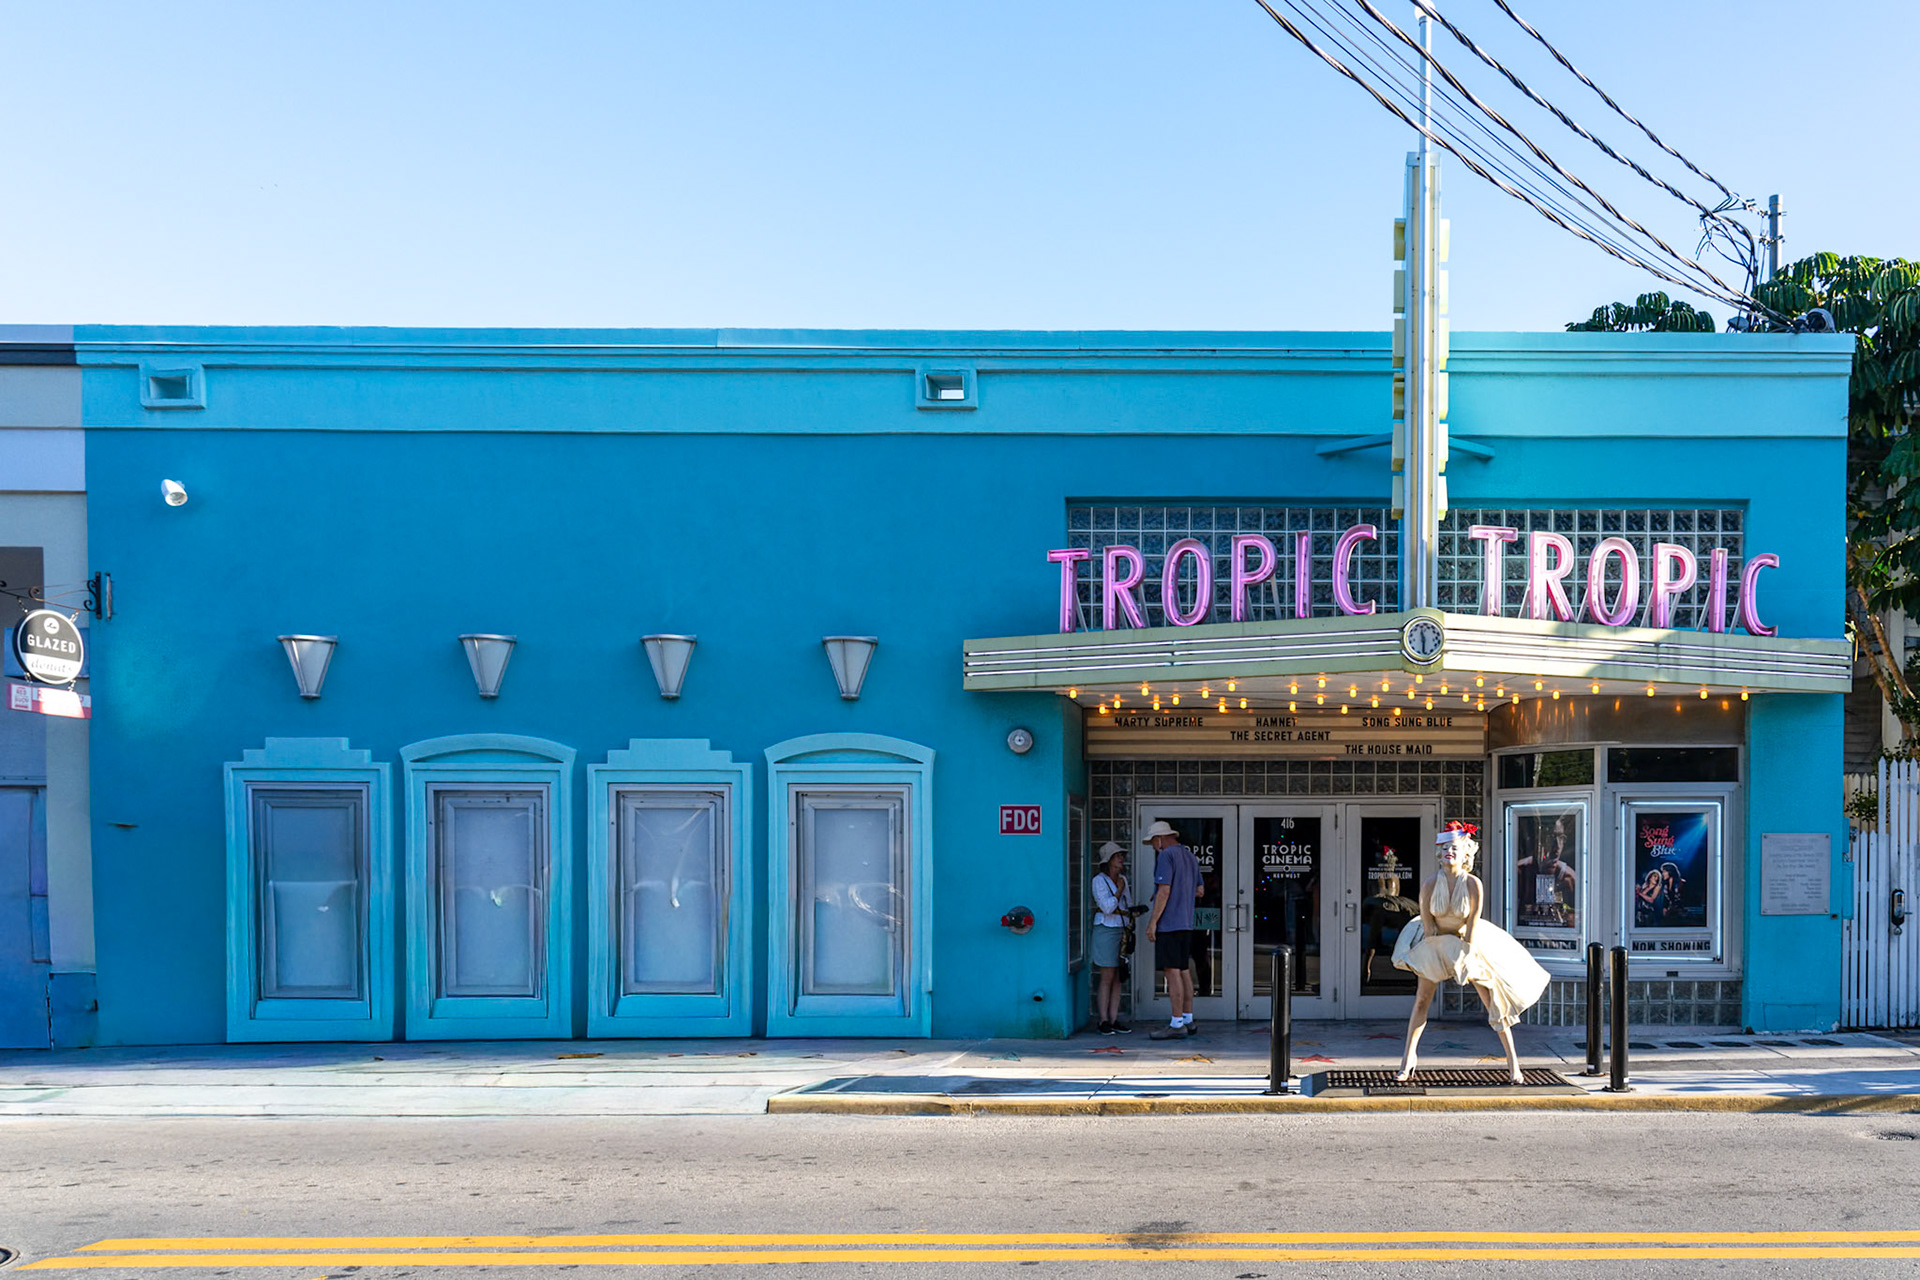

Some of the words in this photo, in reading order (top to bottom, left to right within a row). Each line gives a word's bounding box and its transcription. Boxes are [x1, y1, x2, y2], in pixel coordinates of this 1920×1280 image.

[1047, 523, 1378, 633] TROPIC
[1468, 523, 1779, 637] TROPIC
[27, 633, 76, 654] GLAZED
[1114, 717, 1150, 727] MARTY
[1154, 717, 1204, 727] SUPREME
[1256, 717, 1297, 727] HAMNET
[1362, 717, 1390, 727] SONG
[1394, 717, 1422, 727] SUNG
[1426, 717, 1452, 727] BLUE
[1230, 731, 1249, 741] THE
[1254, 731, 1293, 741] SECRET
[1297, 731, 1331, 741] AGENT
[1345, 744, 1364, 755] THE
[1367, 744, 1402, 755] HOUSE
[1406, 744, 1433, 755] MAID
[1002, 809, 1039, 831] FDC
[1280, 817, 1295, 829] 416
[1640, 825, 1669, 839] Song
[1644, 835, 1675, 849] Sung
[1262, 844, 1311, 855] TROPIC
[1650, 844, 1676, 857] Blue
[1261, 855, 1312, 864] CINEMA
[1632, 940, 1656, 951] NOW
[1661, 940, 1711, 951] SHOWING
